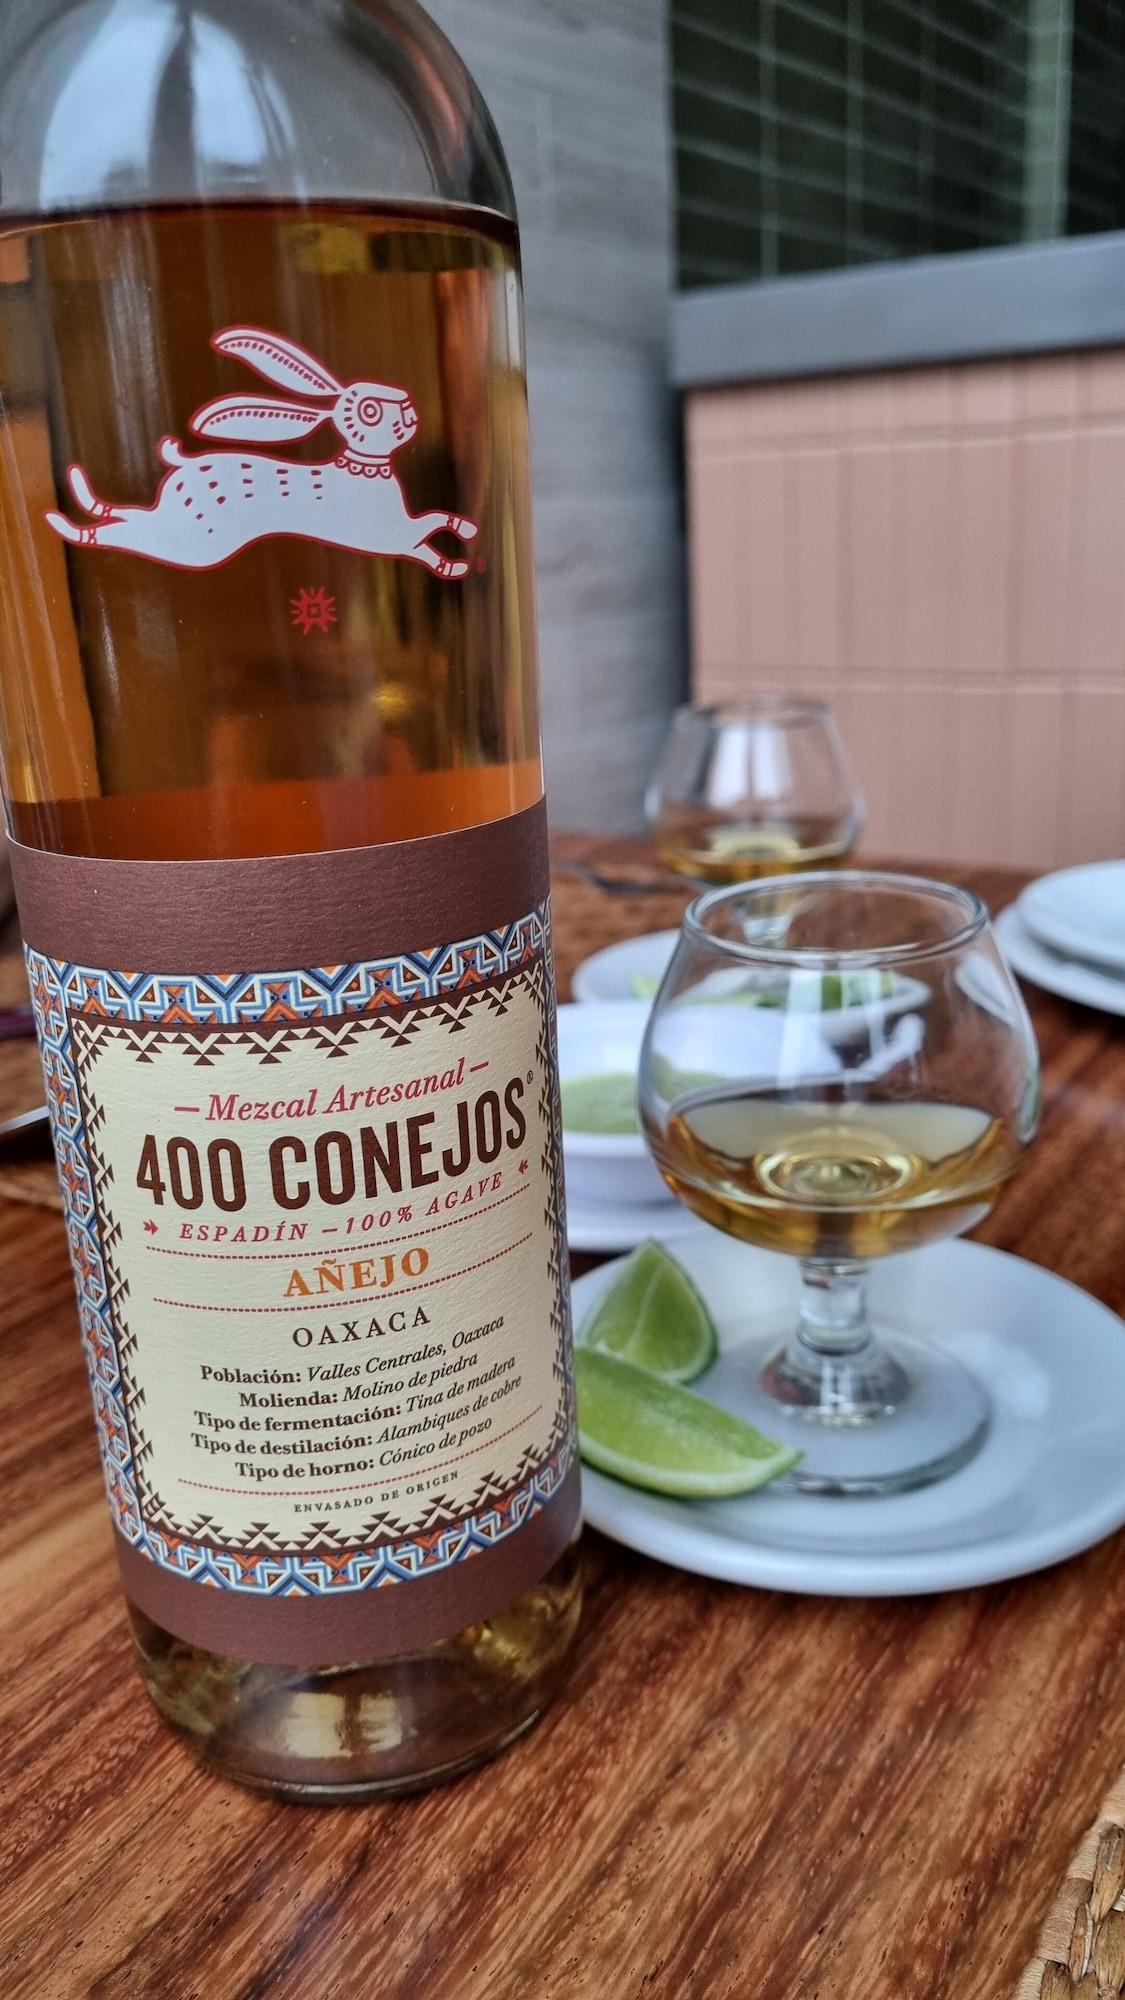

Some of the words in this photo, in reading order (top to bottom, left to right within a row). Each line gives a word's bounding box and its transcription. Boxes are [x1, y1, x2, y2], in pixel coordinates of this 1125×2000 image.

[136, 1134, 247, 1212] 400
[179, 1221, 308, 1242] ESPADÍN
[425, 1171, 502, 1216] AGAVE
[283, 1247, 429, 1297] AÑEJO
[200, 1365, 302, 1384] Población:
[307, 1363, 361, 1382] Valles
[366, 1344, 447, 1374] Centrales,
[452, 1315, 504, 1349] Oaxaca
[292, 1306, 431, 1347] OAXACA
[194, 1411, 235, 1432] Tipo
[239, 1416, 261, 1431] de
[265, 1405, 401, 1431] fermentación:
[406, 1391, 444, 1413] Tina
[447, 1382, 464, 1397] de
[466, 1356, 515, 1392] madera
[238, 1391, 338, 1408] Molienda:
[342, 1377, 405, 1402] Molino
[408, 1371, 427, 1388] de
[428, 1353, 478, 1387] piedra
[191, 1433, 231, 1454] Tipo
[235, 1440, 257, 1454] de
[260, 1434, 373, 1455] destilación:
[376, 1404, 470, 1443] Alambiques
[472, 1395, 488, 1411] de
[490, 1375, 522, 1403] cobre
[235, 1462, 279, 1481] Tipo
[282, 1464, 306, 1478] de
[308, 1458, 375, 1477] horno:
[379, 1442, 435, 1466] Cónico
[438, 1433, 457, 1449] de
[458, 1418, 492, 1447] pozo
[294, 1495, 374, 1512] ENVASADO
[381, 1490, 400, 1501] DE
[406, 1470, 459, 1495] ORIGEN
